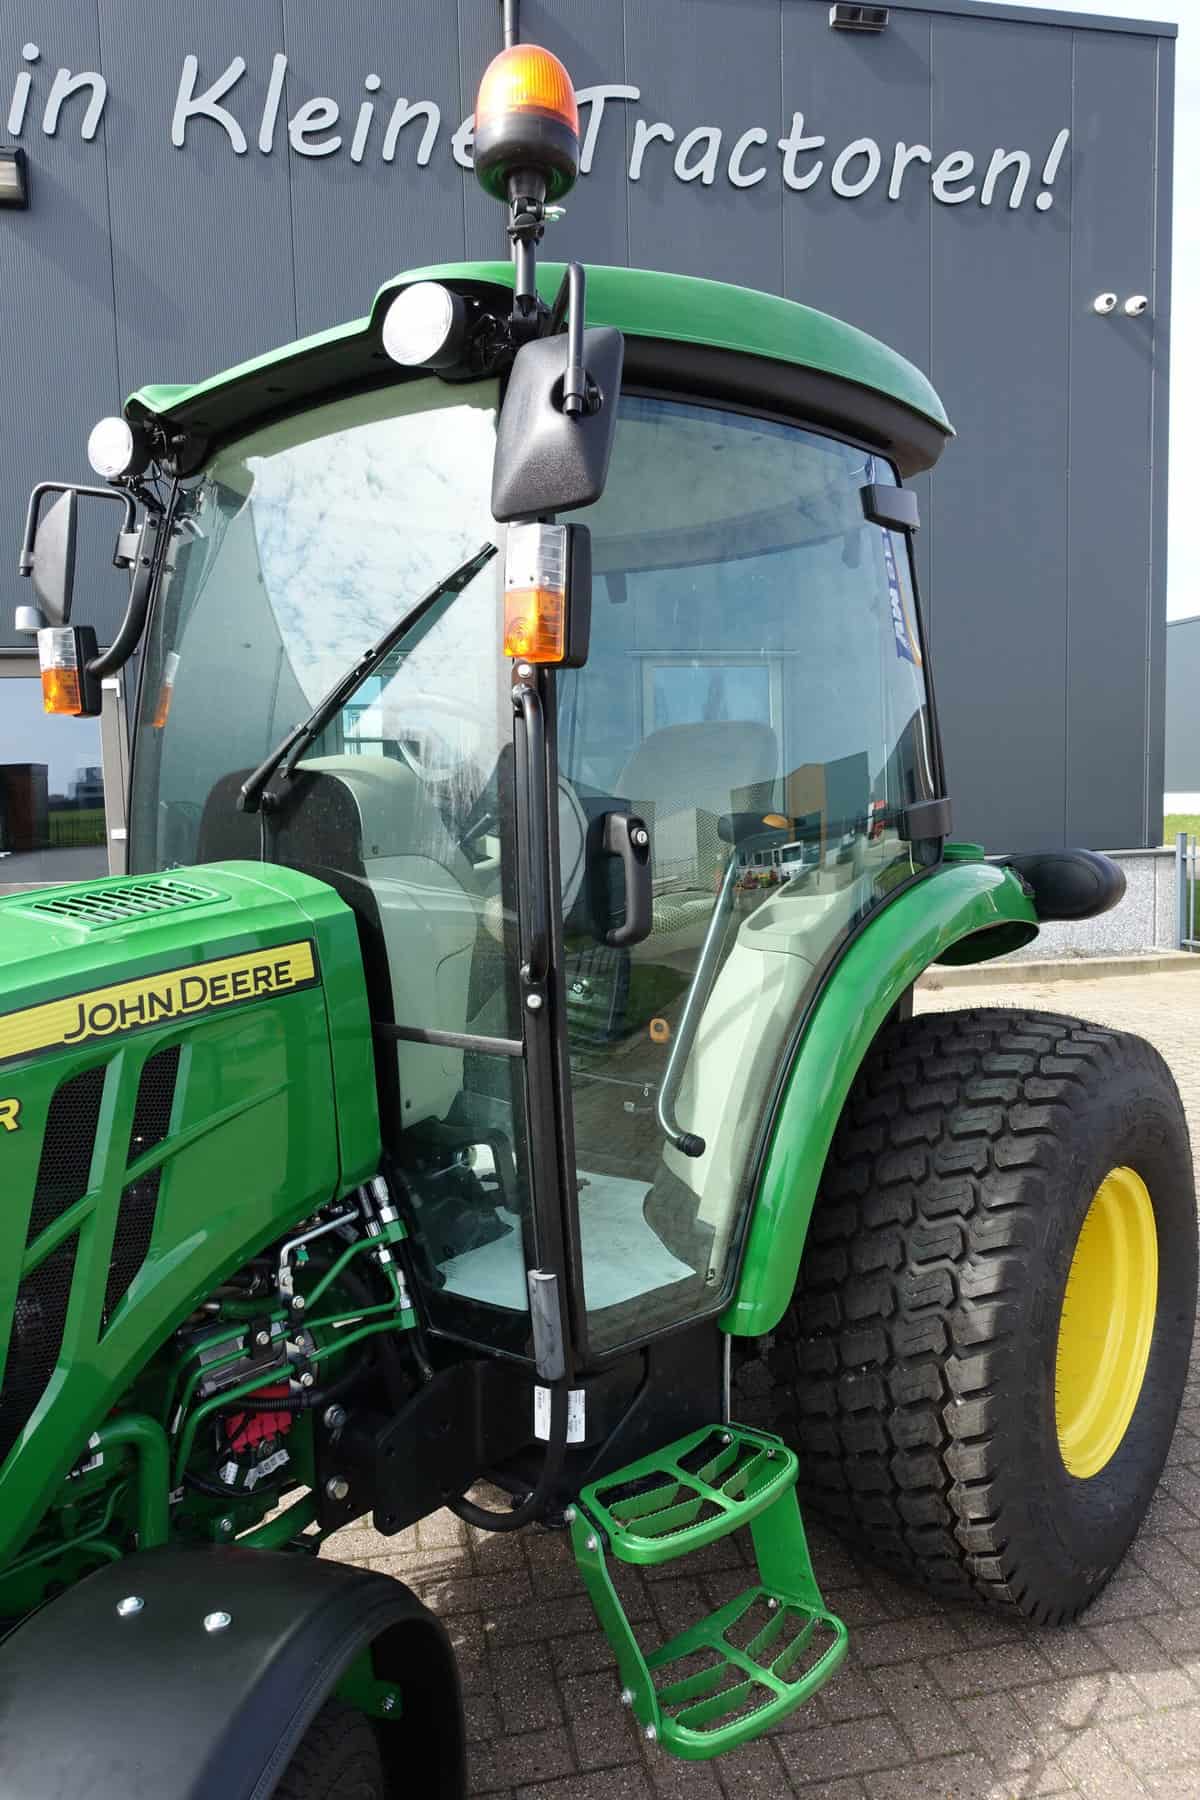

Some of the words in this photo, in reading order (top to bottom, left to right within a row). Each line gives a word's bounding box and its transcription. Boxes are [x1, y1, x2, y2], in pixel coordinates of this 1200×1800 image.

[8, 43, 108, 140] in
[574, 84, 1070, 211] Tractoren!
[63, 986, 174, 1040] JOHN
[179, 960, 293, 1010] DEERE
